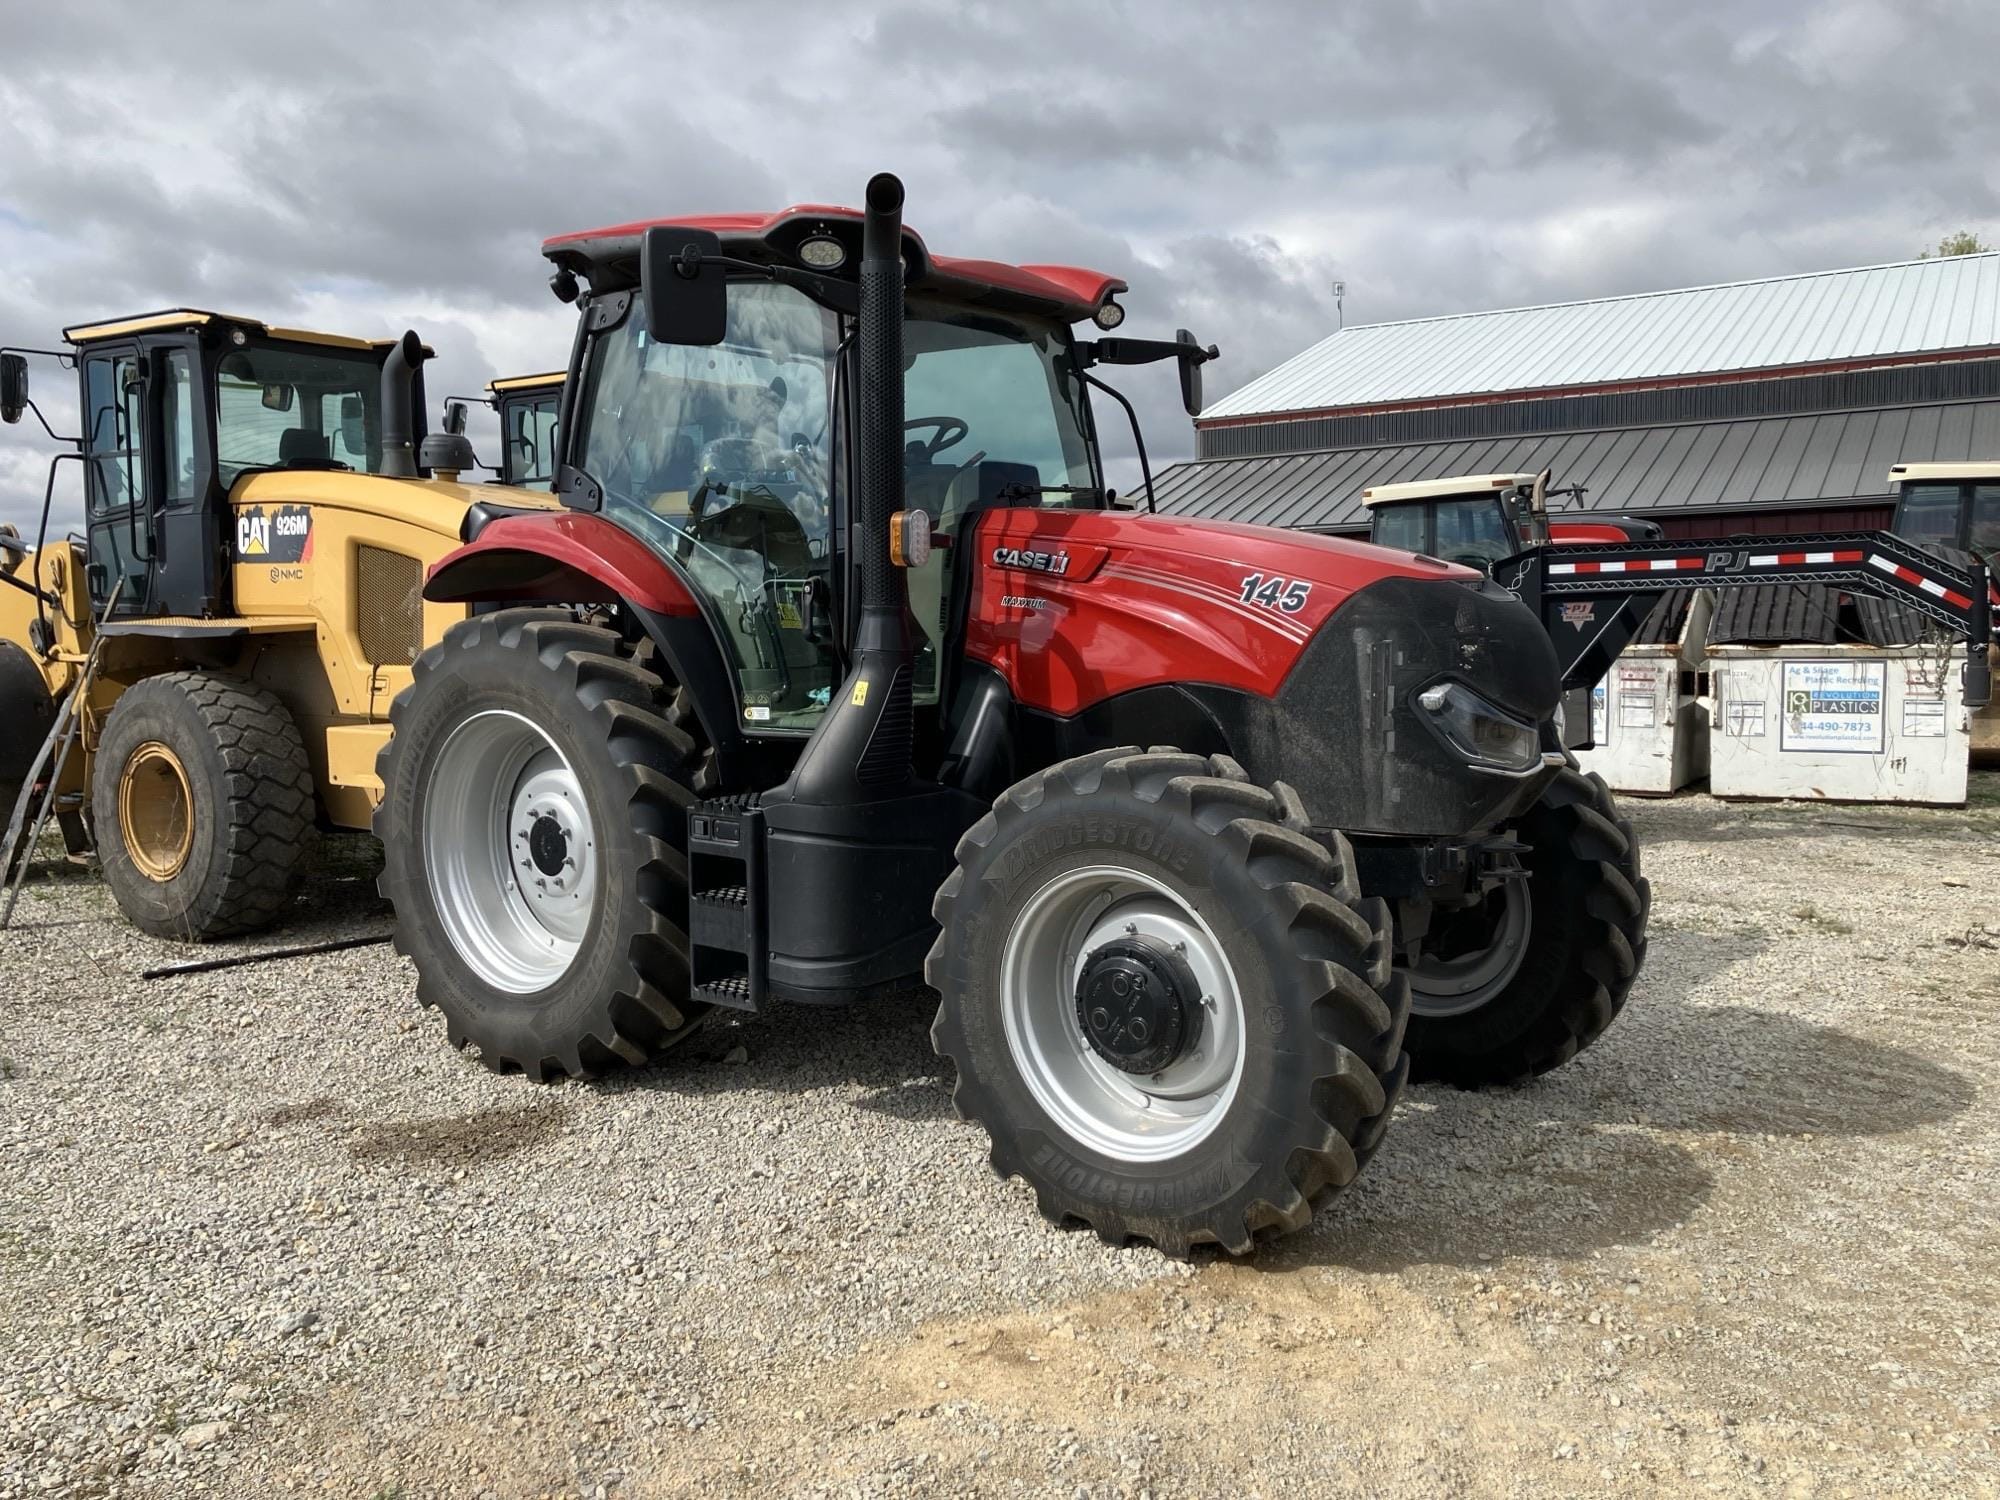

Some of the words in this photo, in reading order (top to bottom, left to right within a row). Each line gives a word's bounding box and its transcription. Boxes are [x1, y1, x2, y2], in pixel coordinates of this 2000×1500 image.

[237, 517, 271, 554] CAT
[276, 515, 308, 536] 926M
[1704, 552, 1749, 572] PJ
[281, 569, 303, 580] NMC
[1240, 573, 1313, 613] 145
[1789, 667, 1801, 675] Ag
[1813, 701, 1878, 713] PLASTICS
[1796, 722, 1872, 732] 44-490-7873
